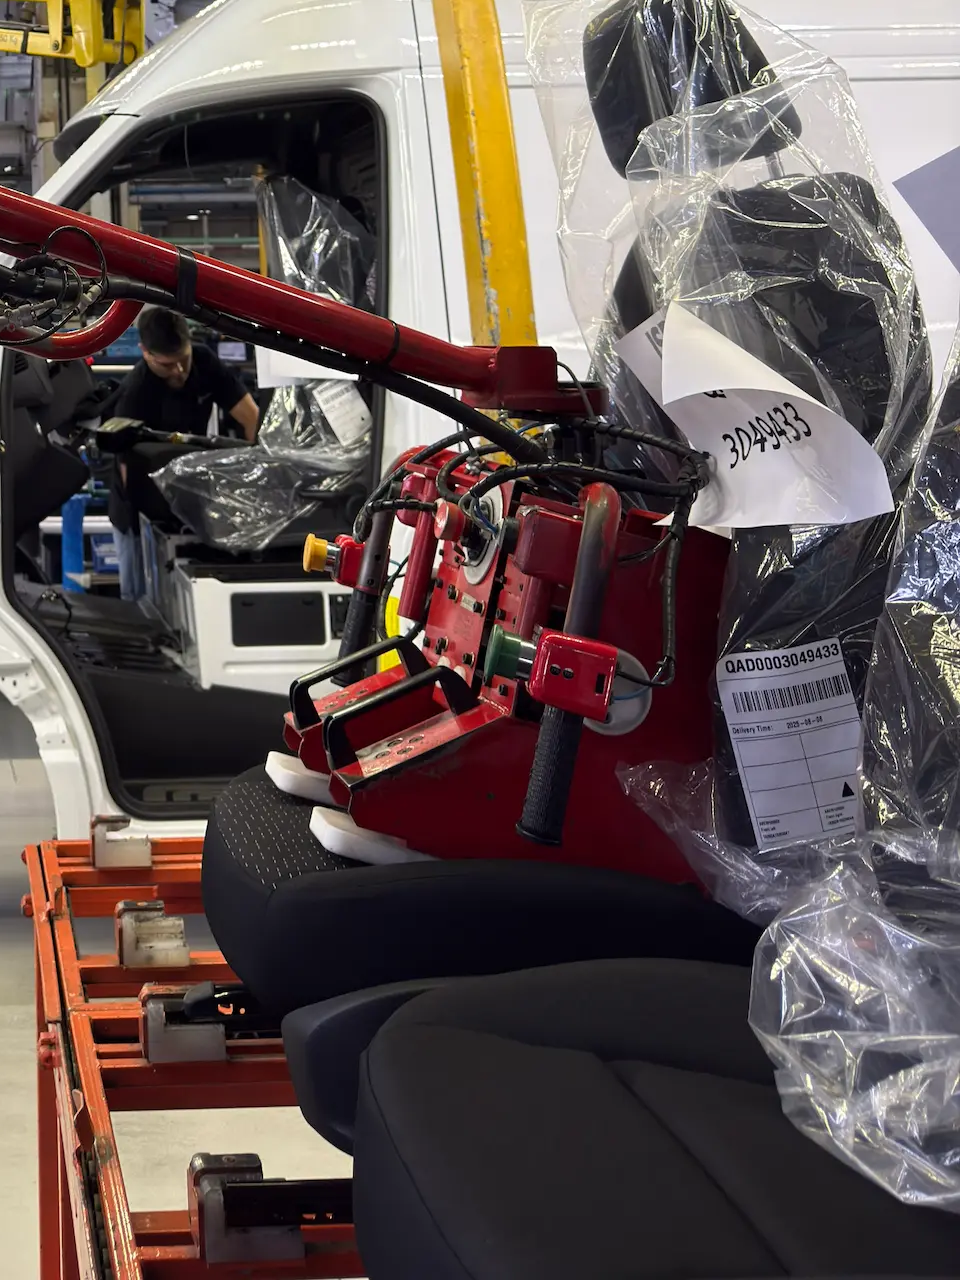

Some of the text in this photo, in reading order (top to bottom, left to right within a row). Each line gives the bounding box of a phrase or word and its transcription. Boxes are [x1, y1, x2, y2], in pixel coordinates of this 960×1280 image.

[725, 643, 840, 674] QAD0003049433
[732, 724, 756, 735] Delivery
[756, 723, 774, 733] Time:
